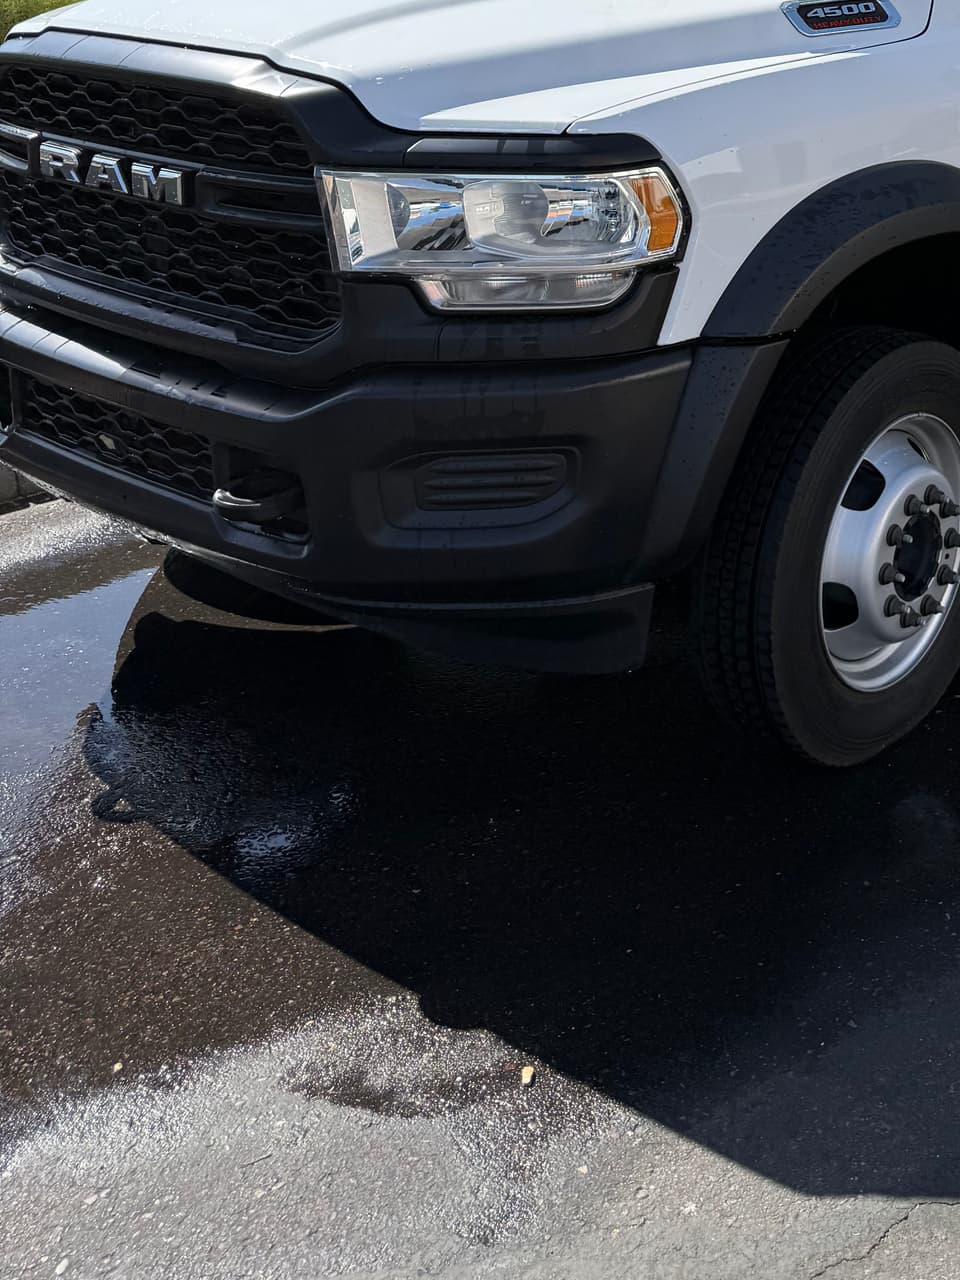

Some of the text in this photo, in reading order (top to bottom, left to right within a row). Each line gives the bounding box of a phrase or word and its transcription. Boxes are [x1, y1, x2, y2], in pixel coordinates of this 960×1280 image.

[806, 2, 876, 18] 4500
[812, 16, 881, 29] HEAVY DUTY
[39, 140, 185, 206] RAM
